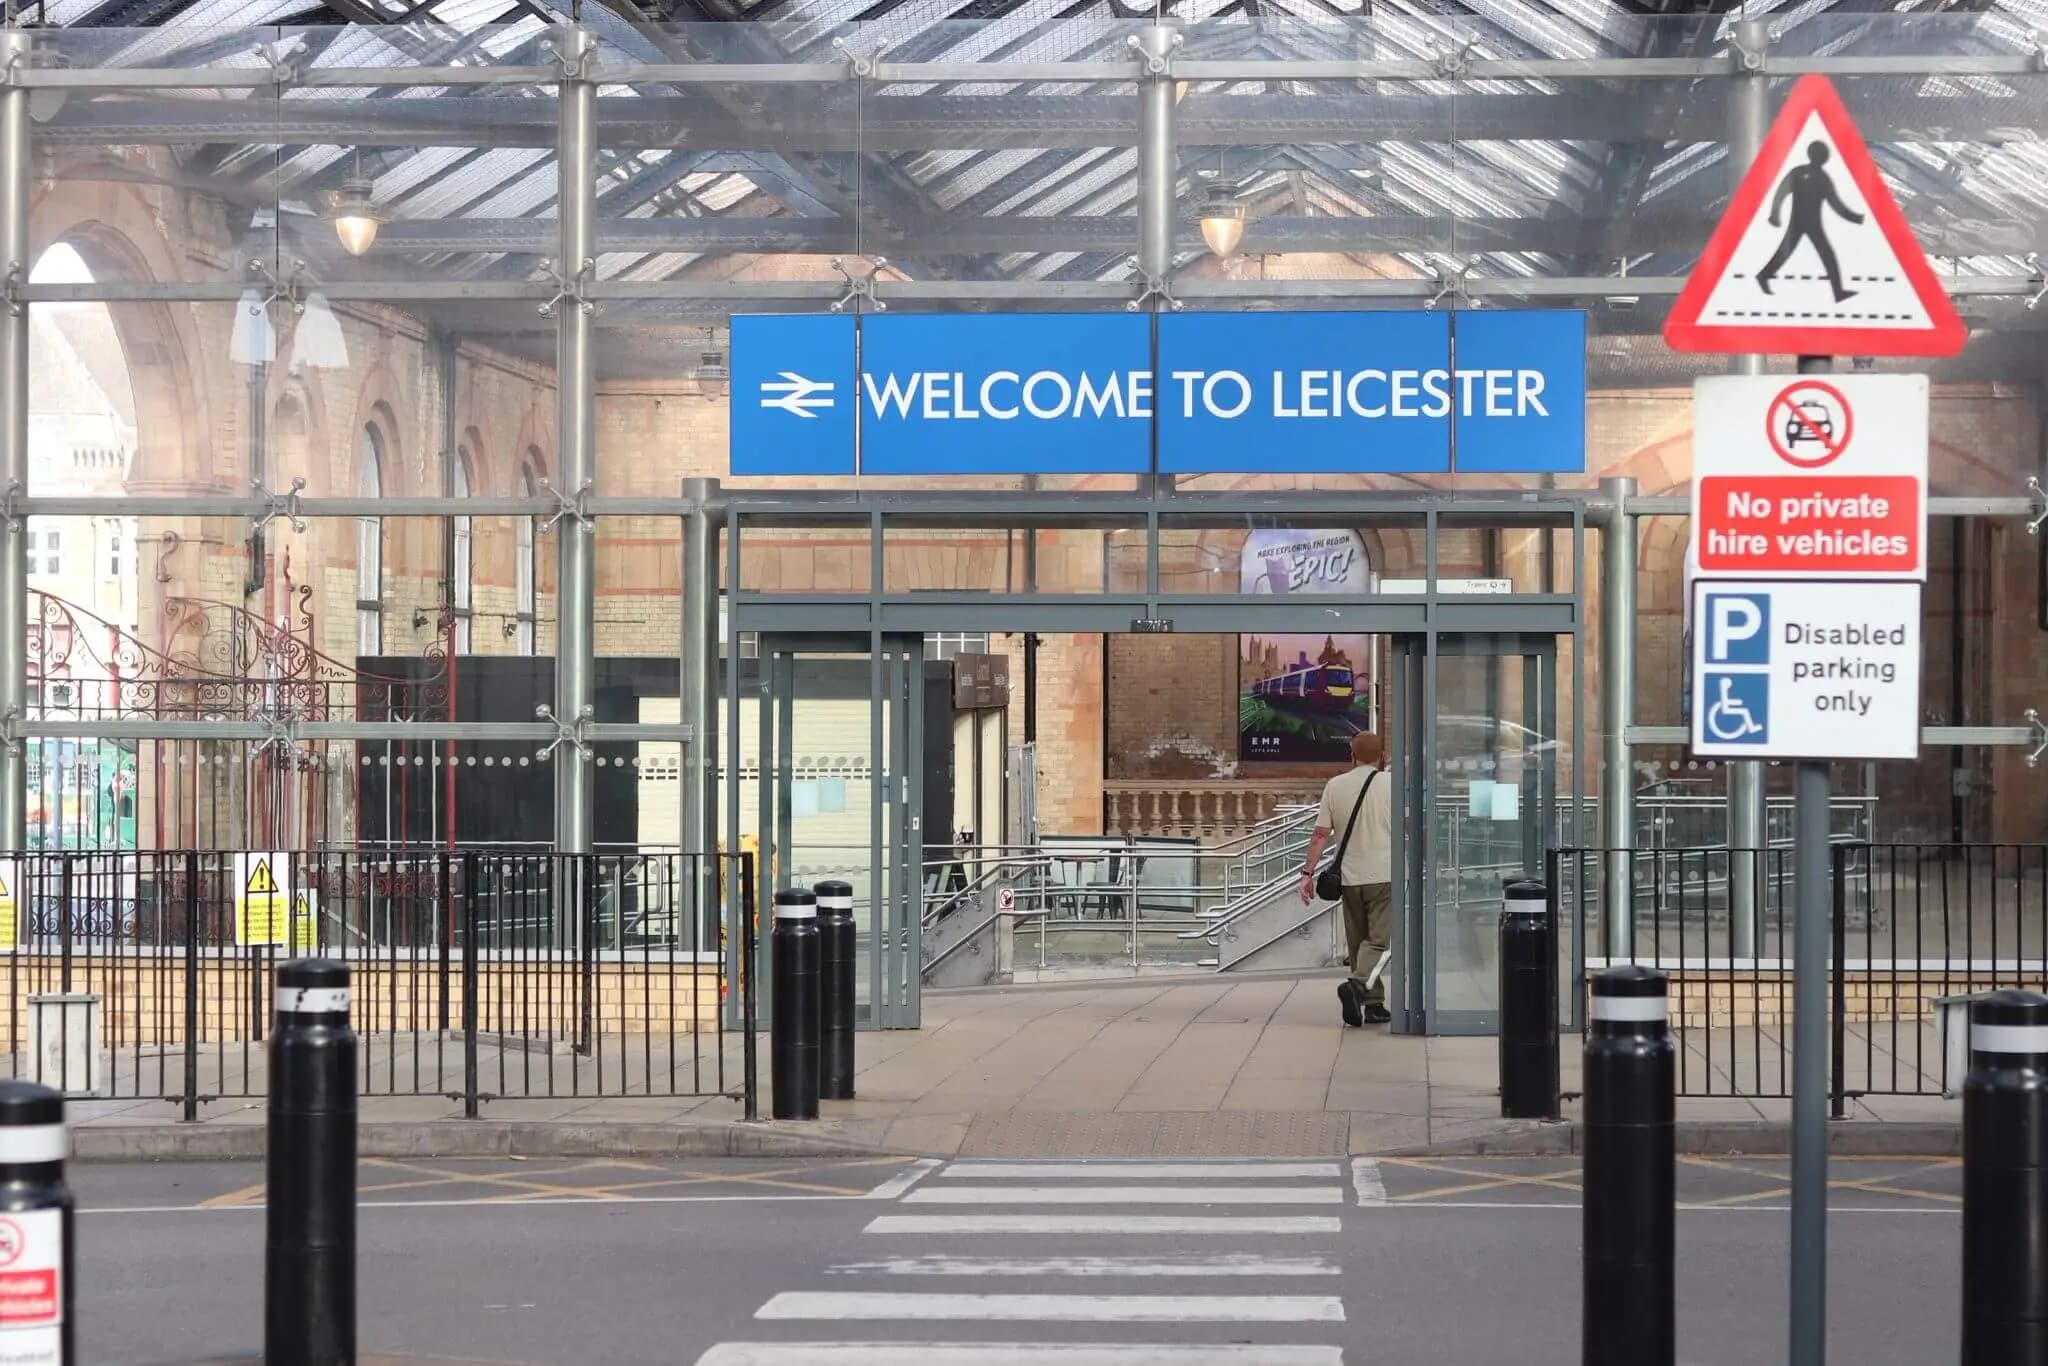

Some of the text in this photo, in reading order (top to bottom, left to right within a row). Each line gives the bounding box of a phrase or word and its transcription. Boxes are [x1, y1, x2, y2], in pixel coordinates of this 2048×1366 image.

[862, 369, 1550, 420] WELCOME TO LEICESTER
[1727, 491, 1889, 525] No private
[1275, 542, 1312, 556] EXPLORING
[1312, 538, 1325, 550] THE
[1326, 535, 1350, 547] REGION
[1707, 528, 1909, 556] hire vehicles
[1287, 547, 1354, 591] EPIC!
[1713, 598, 1762, 660] P
[1785, 622, 1905, 646] Disabled
[1793, 656, 1896, 683] parking
[1815, 690, 1872, 716] only
